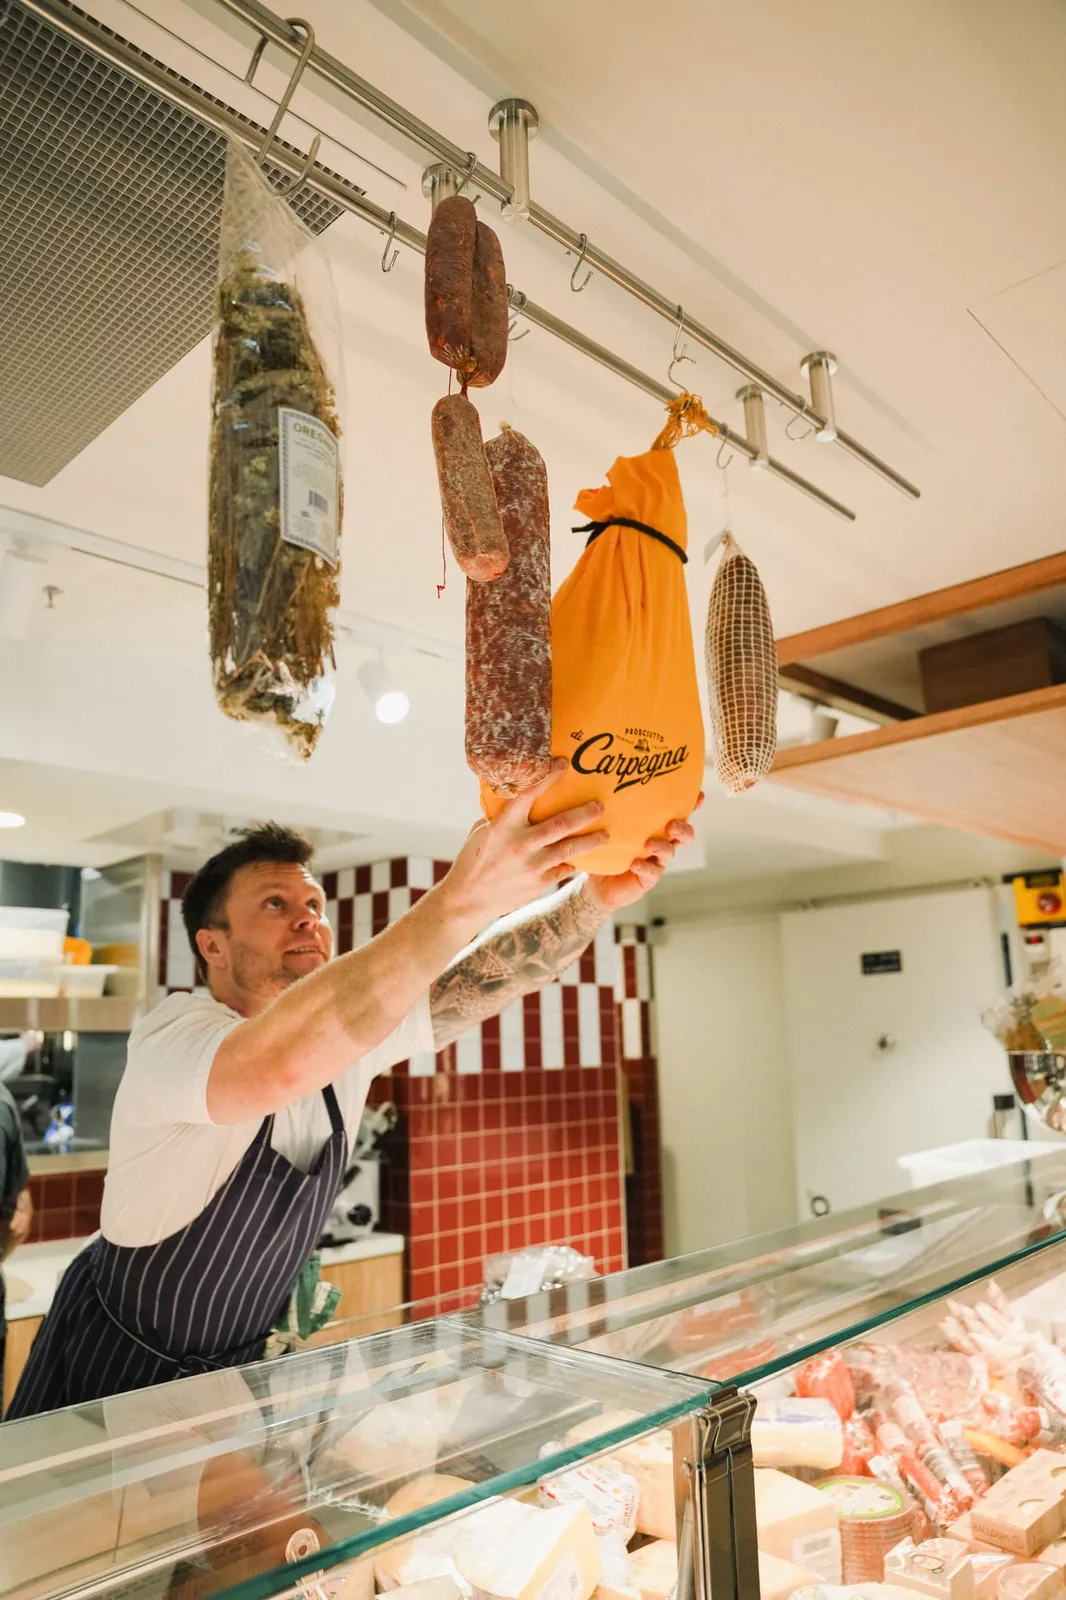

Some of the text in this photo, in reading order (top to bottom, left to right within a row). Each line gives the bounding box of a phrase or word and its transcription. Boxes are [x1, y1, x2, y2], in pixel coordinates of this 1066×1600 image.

[625, 728, 664, 742] PROSCIUTTO
[570, 729, 689, 785] di Carpegna
